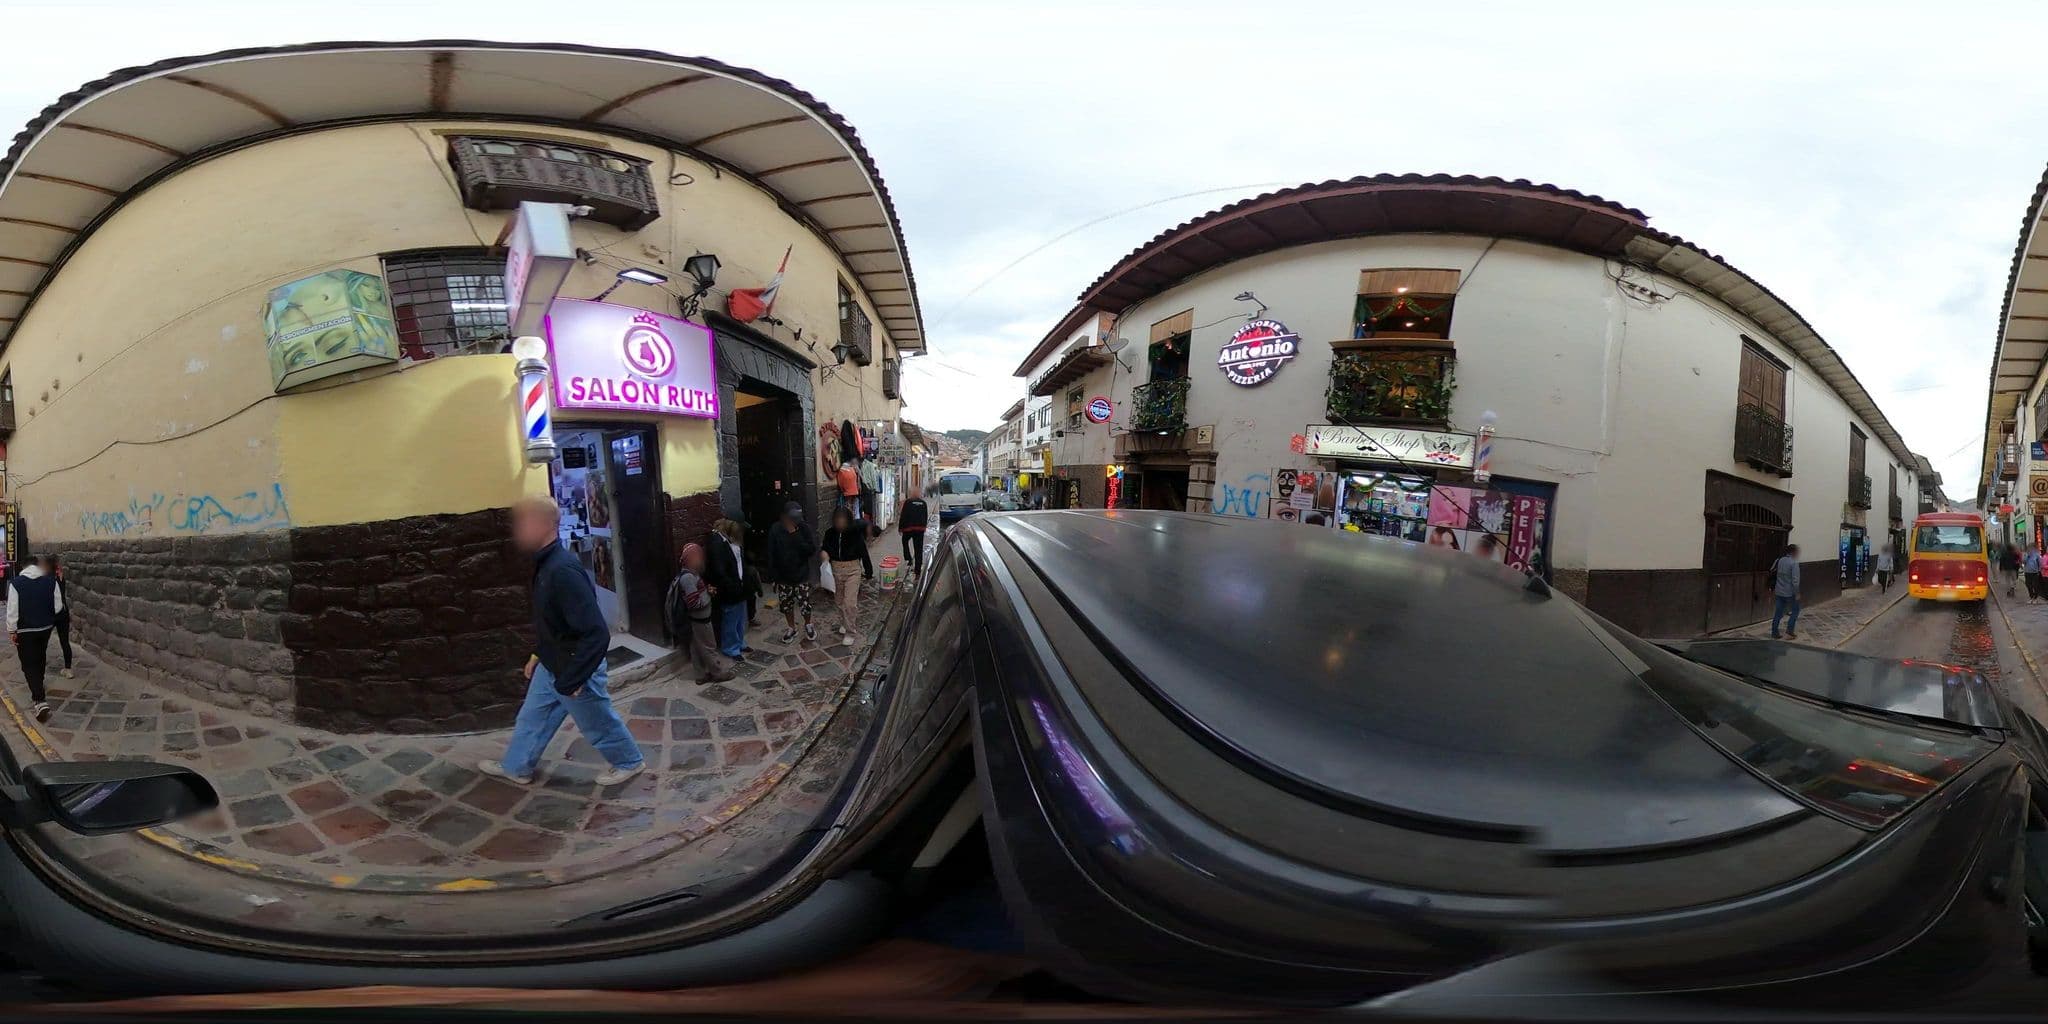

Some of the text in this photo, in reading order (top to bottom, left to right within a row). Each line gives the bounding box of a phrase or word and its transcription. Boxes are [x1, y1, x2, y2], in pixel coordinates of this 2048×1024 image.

[1218, 339, 1294, 364] Antonio
[1227, 367, 1273, 385] PIZZERIA
[571, 374, 719, 412] SALÓN RUTH
[1322, 427, 1376, 446] Barber
[1380, 430, 1421, 455] Shop
[6, 504, 15, 560] MARKET
